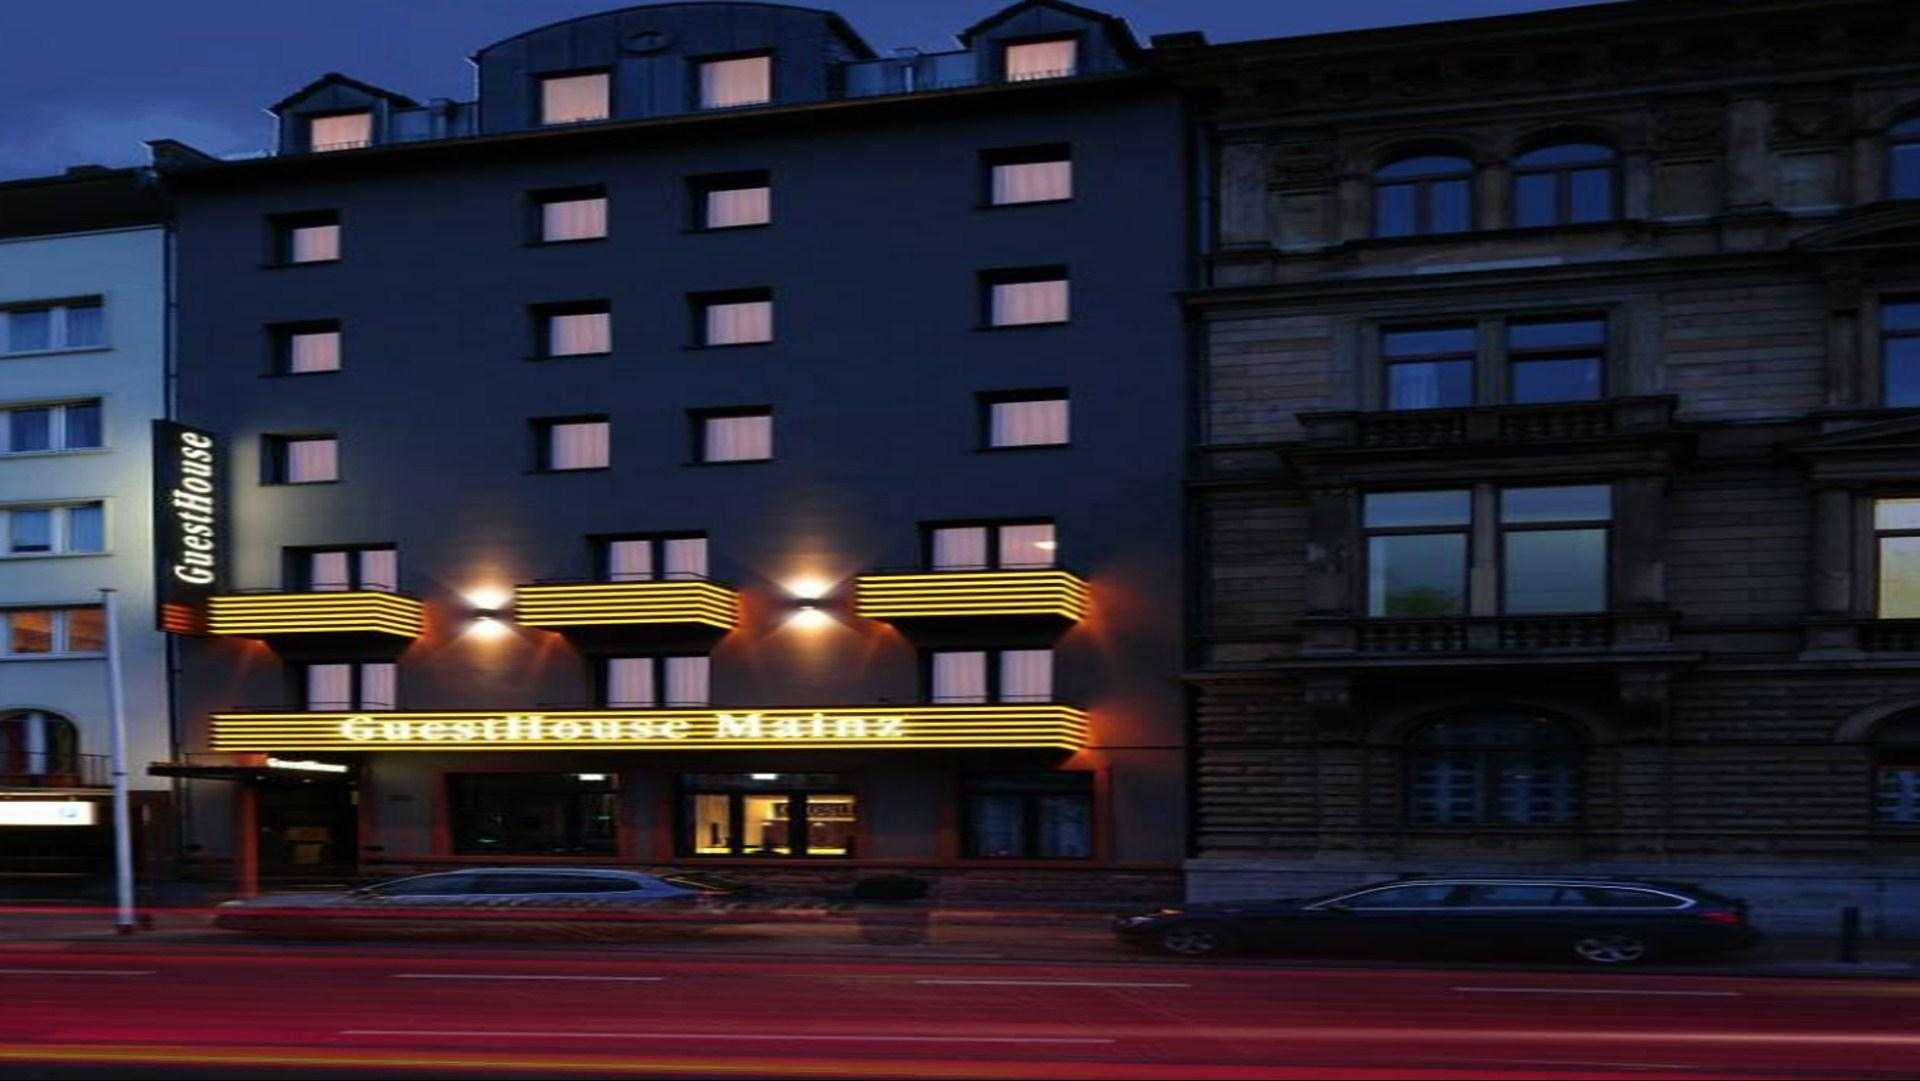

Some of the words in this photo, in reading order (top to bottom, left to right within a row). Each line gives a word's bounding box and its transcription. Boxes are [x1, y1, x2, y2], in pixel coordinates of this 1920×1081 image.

[173, 432, 215, 585] GuestHouse
[338, 713, 694, 742] GuestHouse
[714, 712, 907, 739] Mainz
